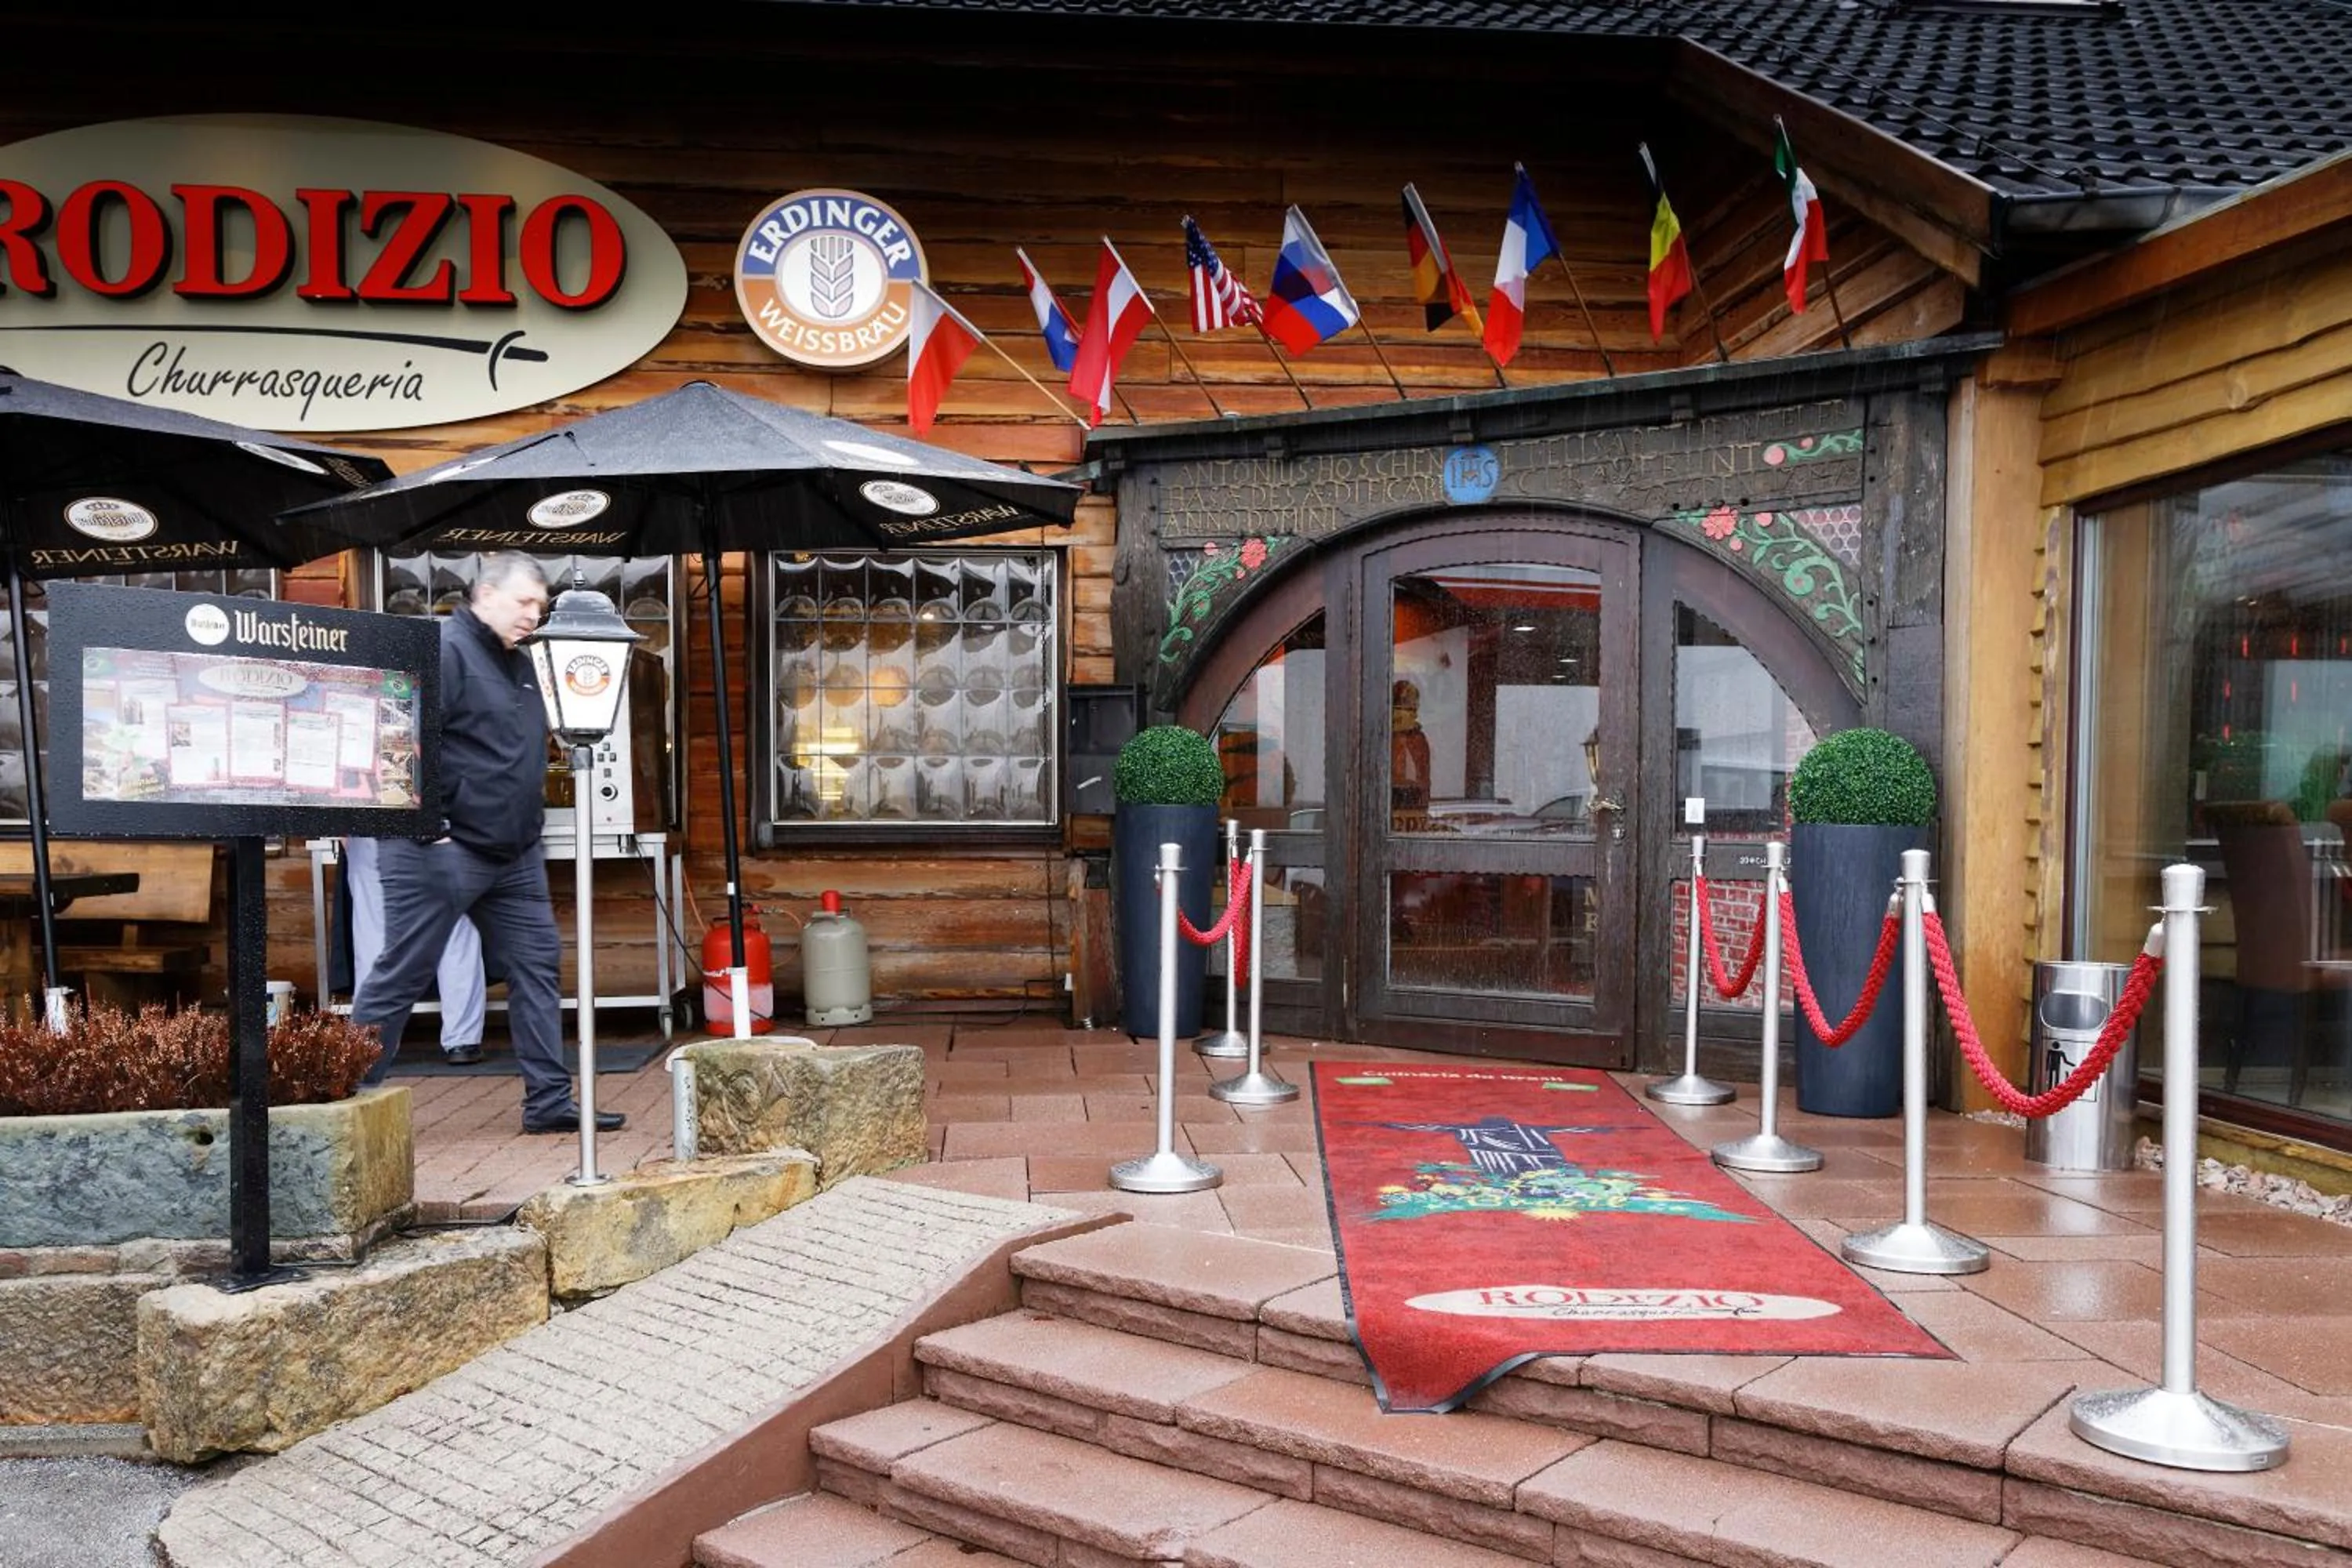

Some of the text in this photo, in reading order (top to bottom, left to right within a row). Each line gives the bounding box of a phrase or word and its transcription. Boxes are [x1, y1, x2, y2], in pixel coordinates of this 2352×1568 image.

[749, 200, 912, 269] ERDINGER
[759, 298, 908, 354] WEISSBRÄU
[127, 341, 423, 420] Churrasqueria
[1452, 458, 1494, 489] IHS
[234, 609, 349, 653] Warsteiner
[1478, 1290, 1766, 1308] RODIZIO
